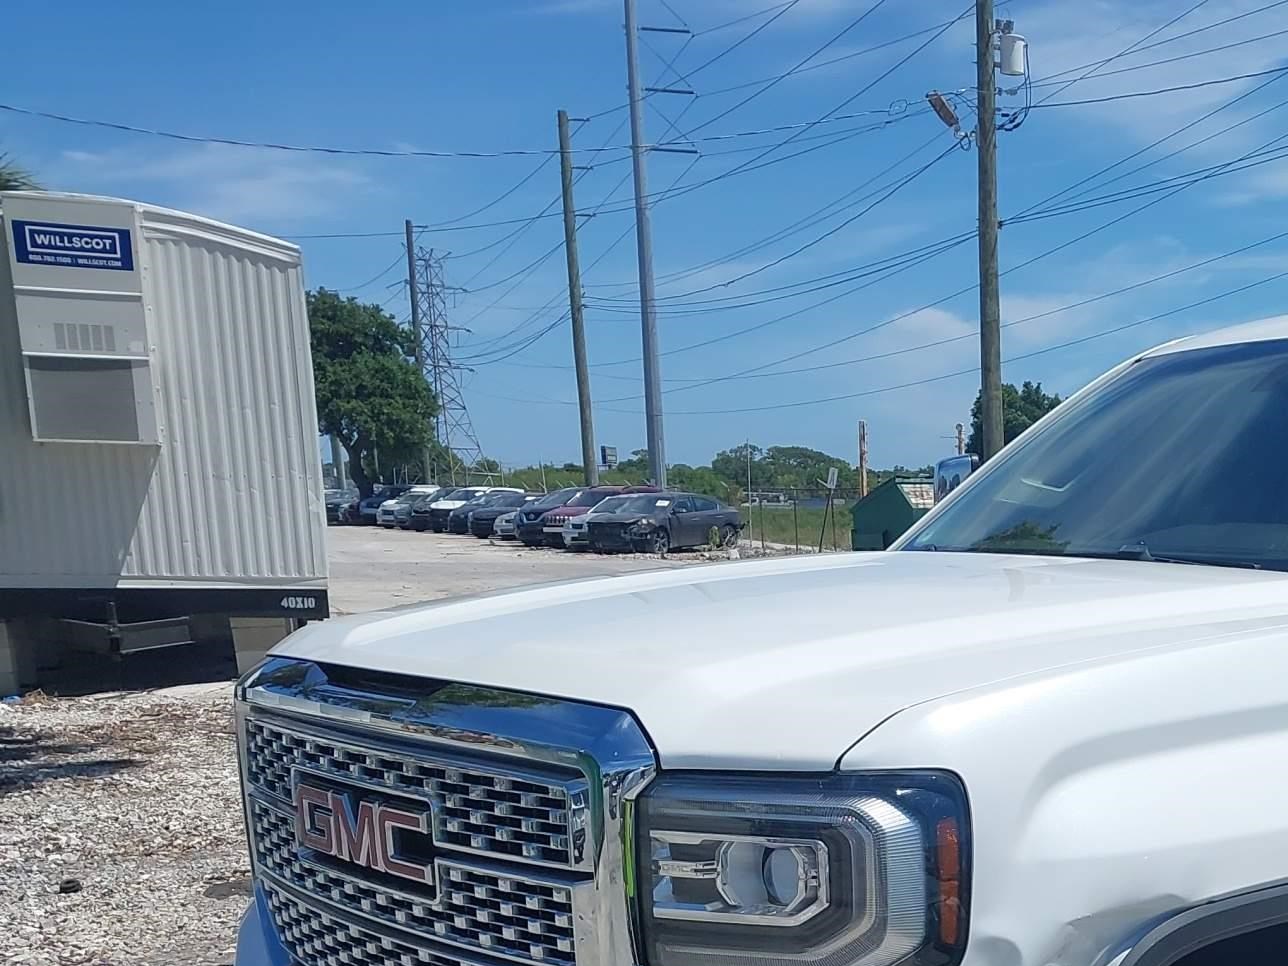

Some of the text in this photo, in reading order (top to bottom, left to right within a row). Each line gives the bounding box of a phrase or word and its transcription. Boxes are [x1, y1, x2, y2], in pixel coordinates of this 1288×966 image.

[34, 233, 112, 250] WILLSCOT
[281, 597, 316, 609] 40X10
[295, 783, 435, 886] GMC
